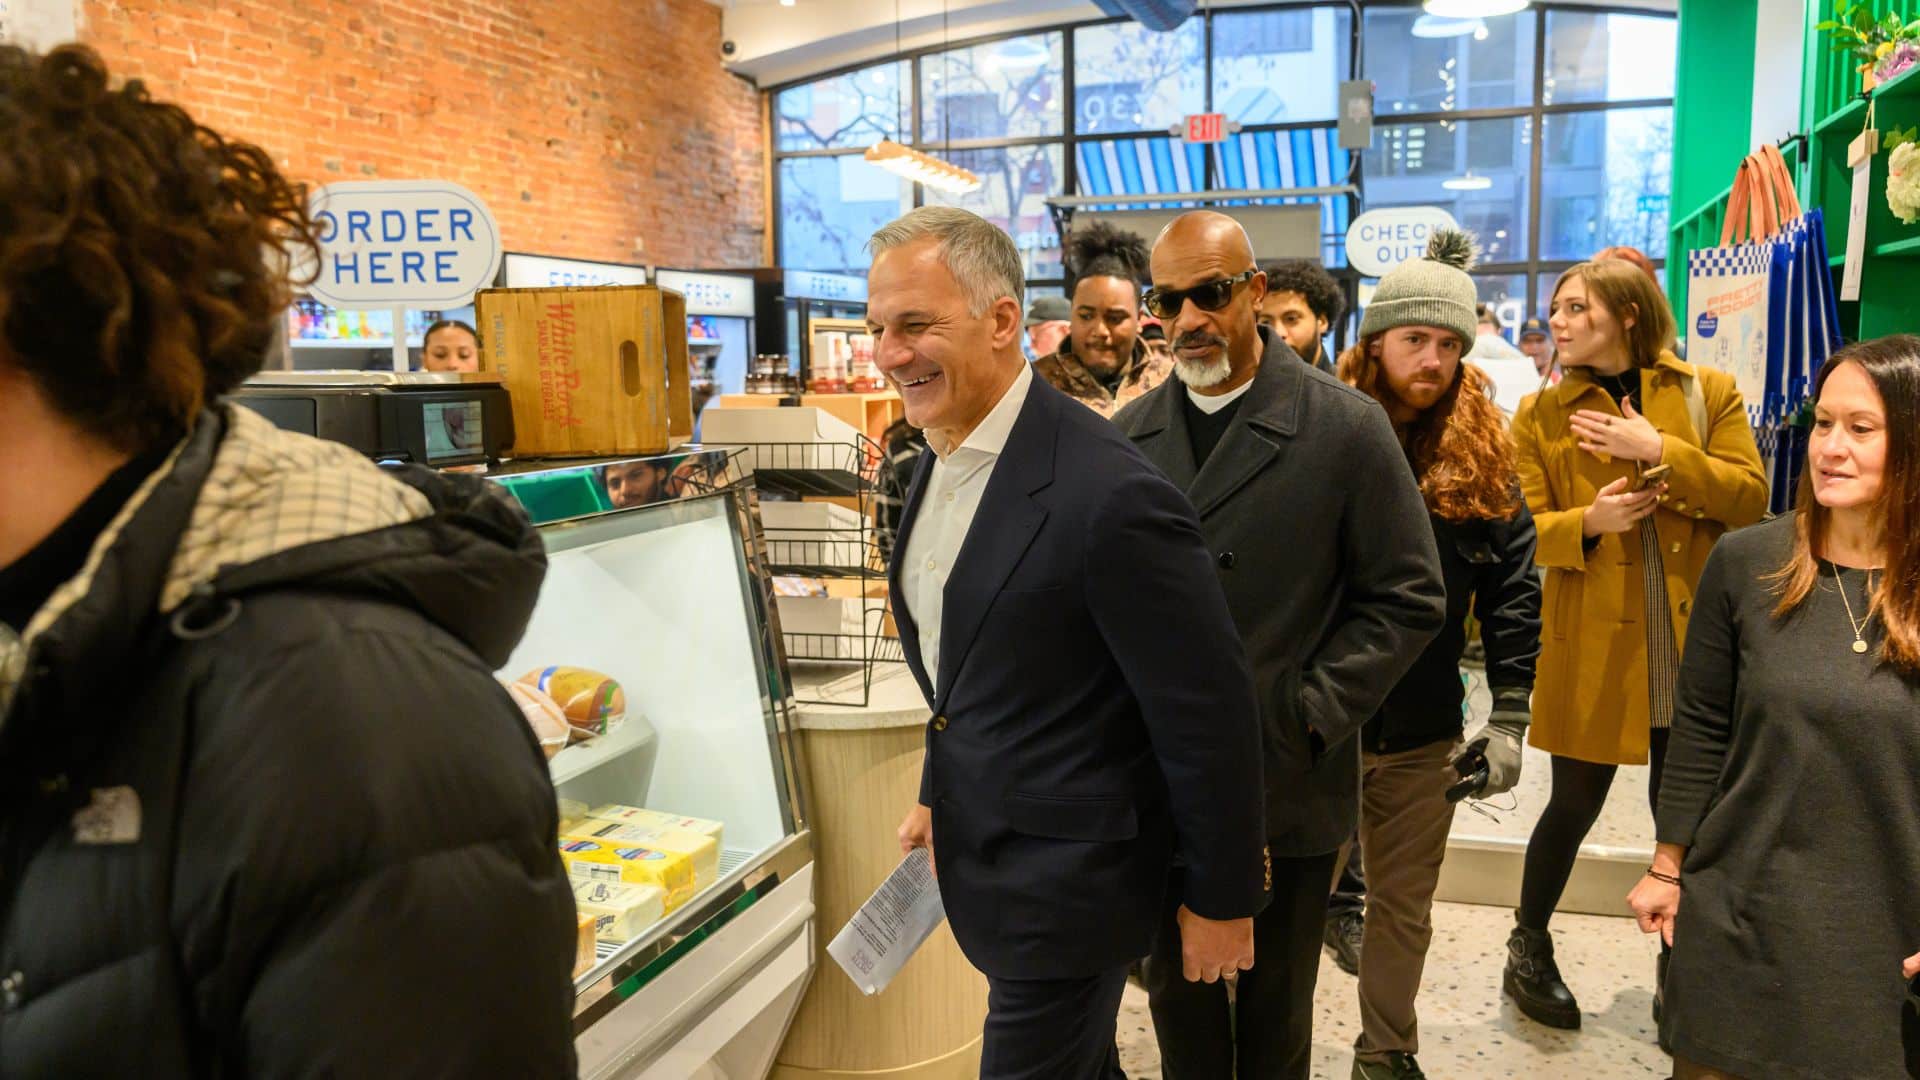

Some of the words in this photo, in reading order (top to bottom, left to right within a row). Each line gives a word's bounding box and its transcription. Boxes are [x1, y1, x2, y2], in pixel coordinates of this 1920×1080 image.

[1189, 114, 1222, 142] EXIT
[313, 209, 474, 243] ORDER
[334, 251, 460, 284] HERE
[546, 303, 577, 366] White
[539, 369, 555, 422] BEVERAGES
[554, 369, 584, 429] Rock
